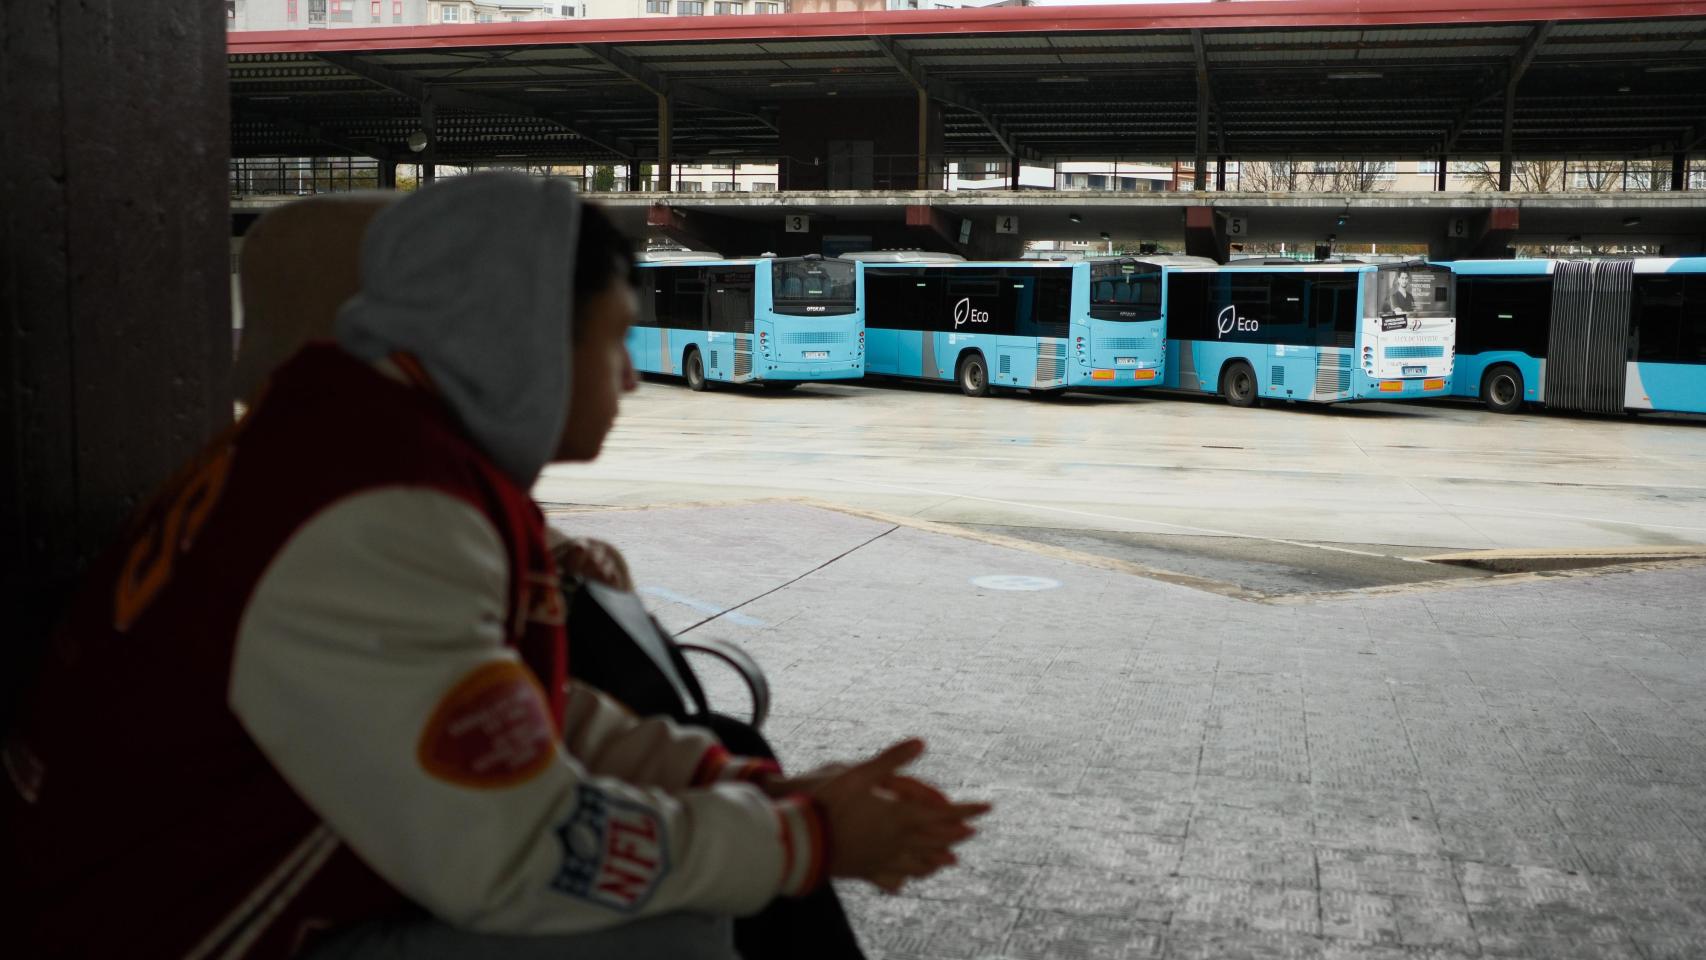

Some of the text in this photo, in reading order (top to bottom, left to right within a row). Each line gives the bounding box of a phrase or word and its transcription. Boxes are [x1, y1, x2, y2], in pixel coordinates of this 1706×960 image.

[793, 217, 802, 230] 3
[1002, 218, 1012, 231] 4
[1232, 220, 1241, 233] 5
[1455, 221, 1464, 234] 6
[971, 309, 989, 323] Eco
[1238, 317, 1259, 332] Eco
[597, 815, 658, 904] NFL
